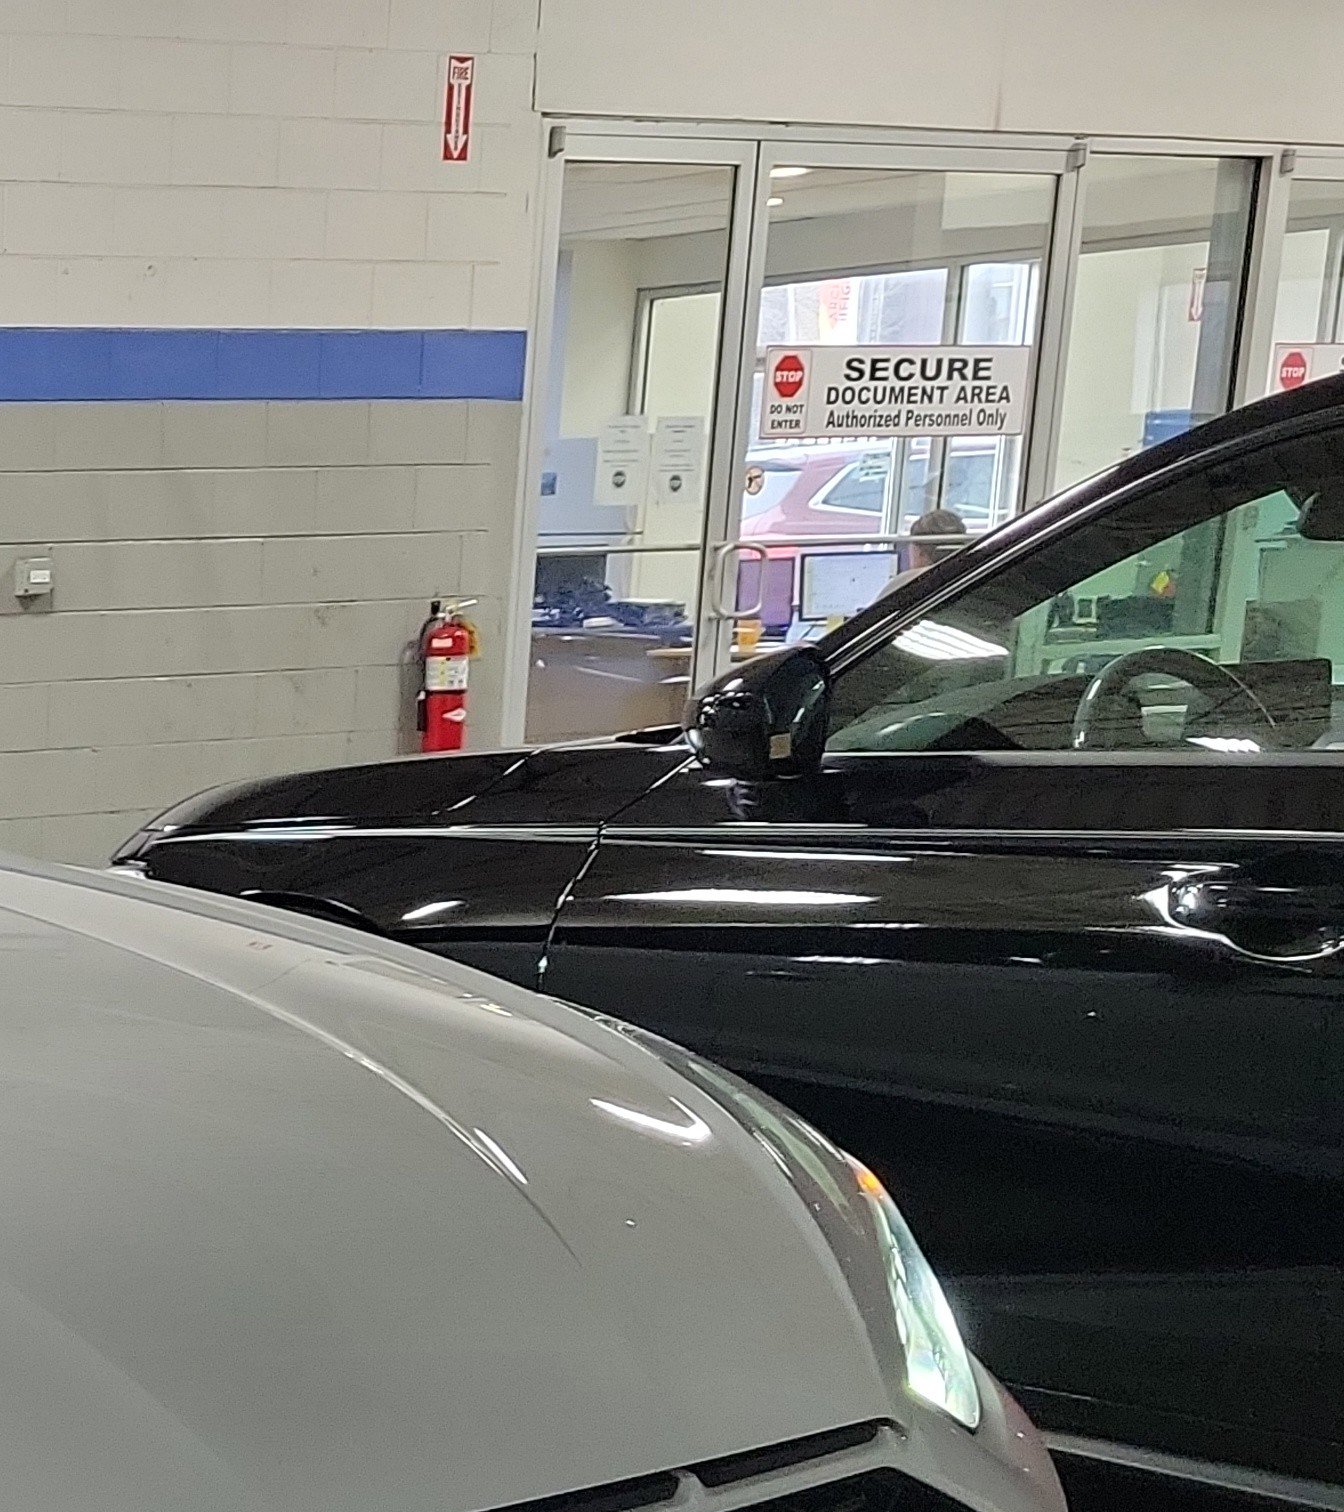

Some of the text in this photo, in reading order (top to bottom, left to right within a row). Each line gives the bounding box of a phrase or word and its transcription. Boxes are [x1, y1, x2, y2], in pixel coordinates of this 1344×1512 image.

[843, 357, 994, 382] SECURE
[1281, 367, 1305, 378] STOP
[775, 371, 804, 383] STOP
[825, 384, 1011, 405] DOCUMENT AREA
[769, 404, 805, 414] DO NOT
[770, 419, 801, 430] ENTER
[825, 407, 1007, 430] Authorized Personnel Only
